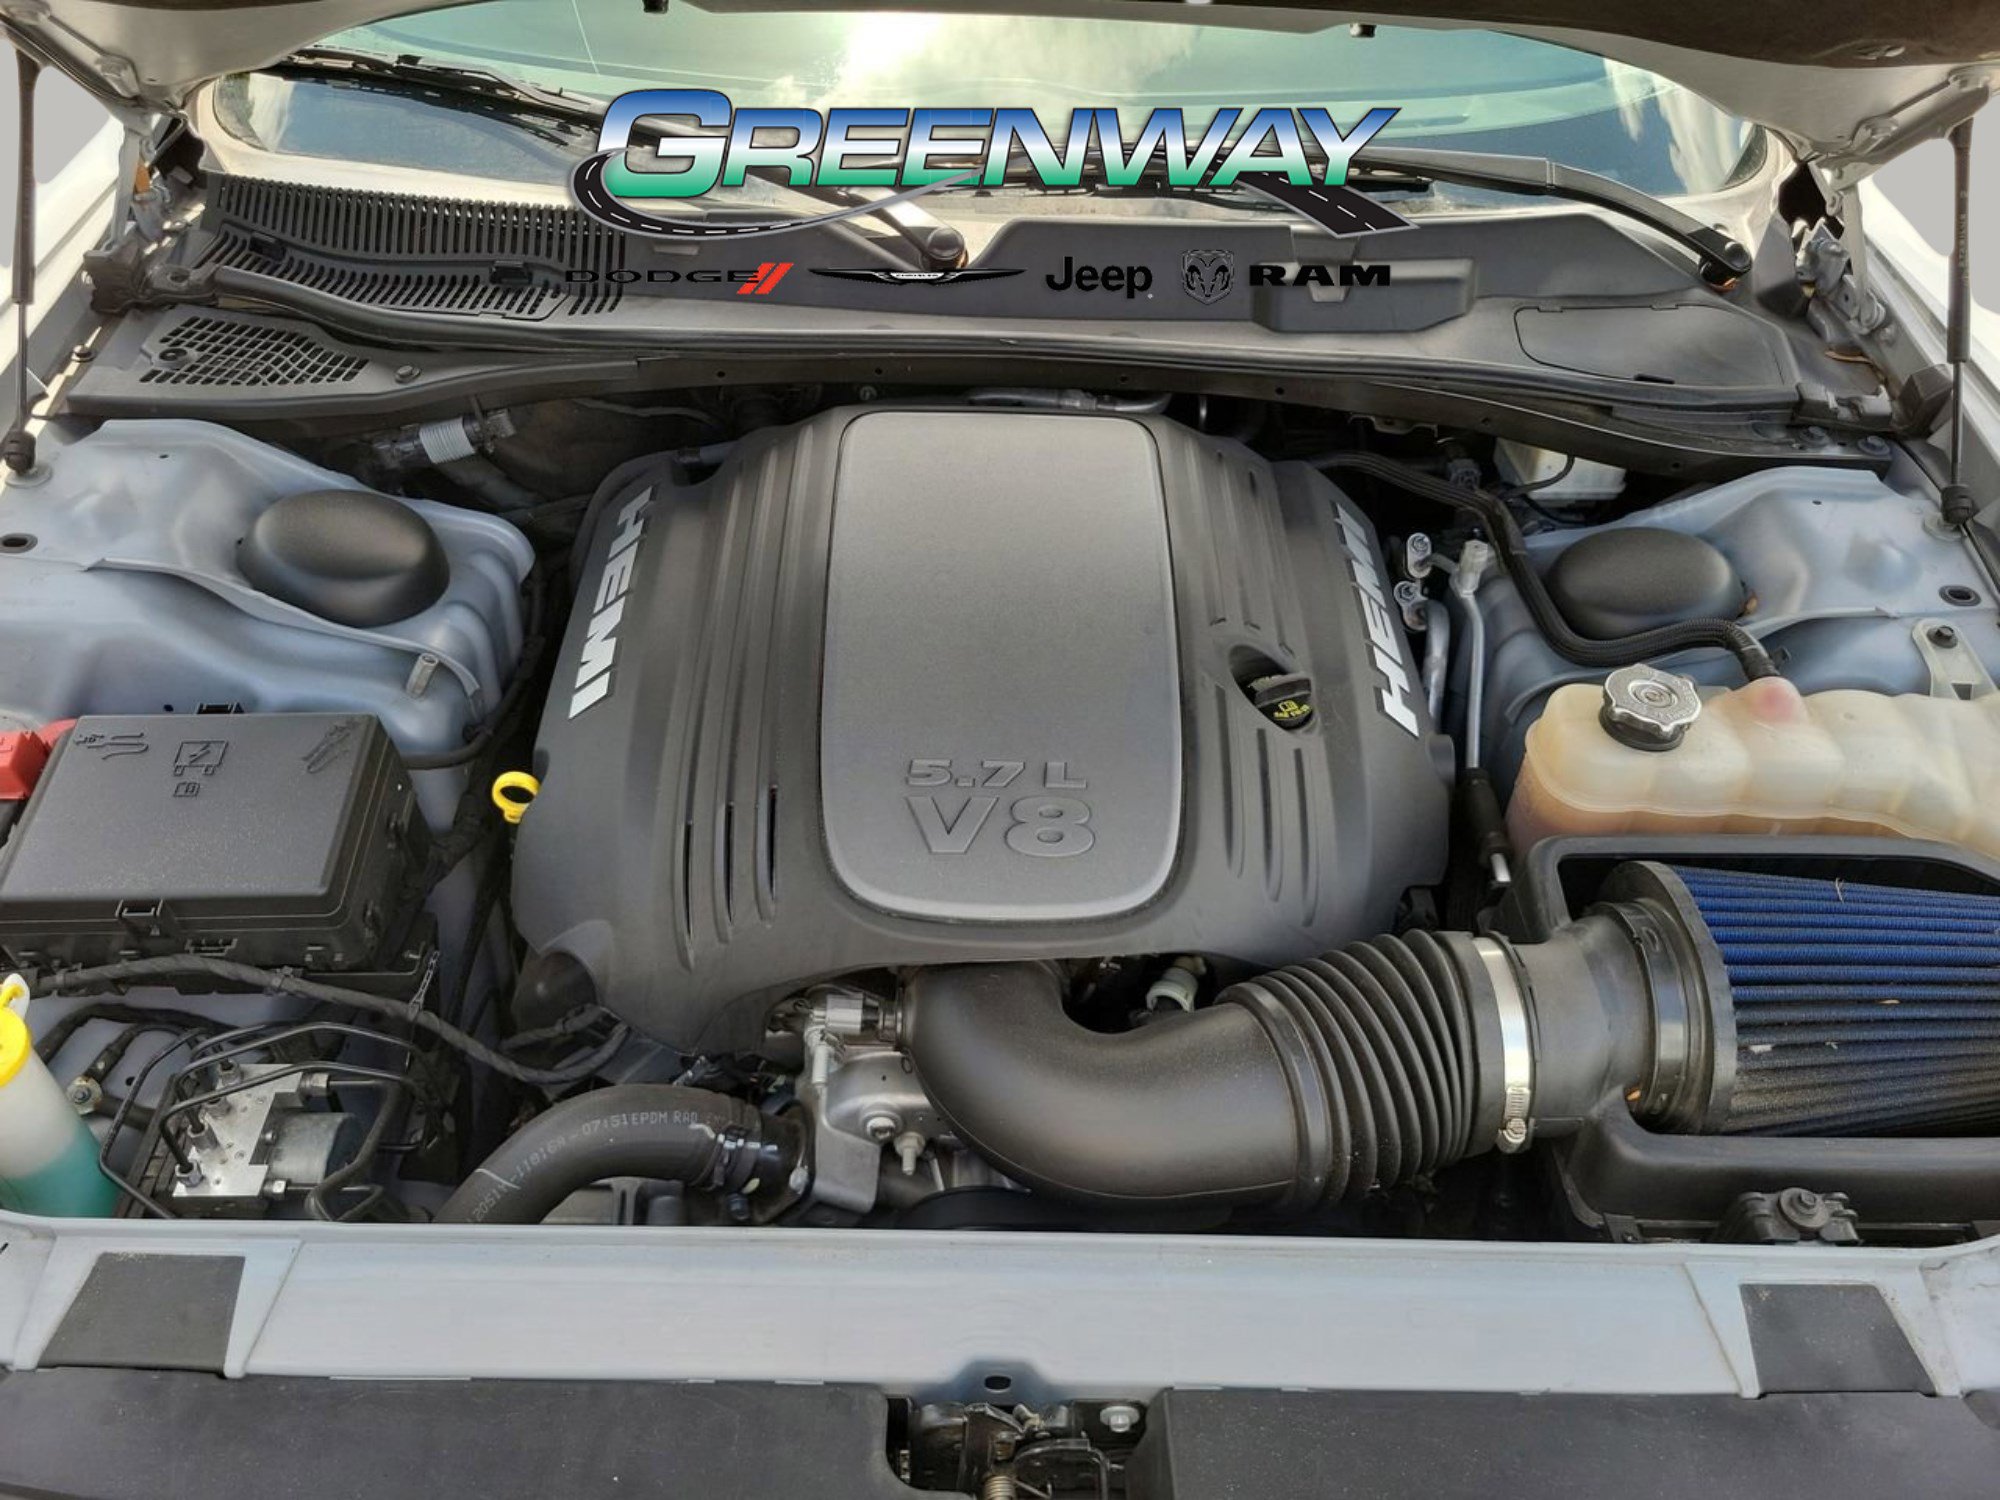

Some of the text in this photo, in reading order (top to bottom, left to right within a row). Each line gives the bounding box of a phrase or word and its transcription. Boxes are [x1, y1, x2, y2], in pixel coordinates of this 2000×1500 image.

[568, 486, 653, 720] HEMI
[1336, 502, 1420, 738] HEMI
[904, 796, 1096, 858] V8
[906, 759, 1088, 788] 5.7 L
